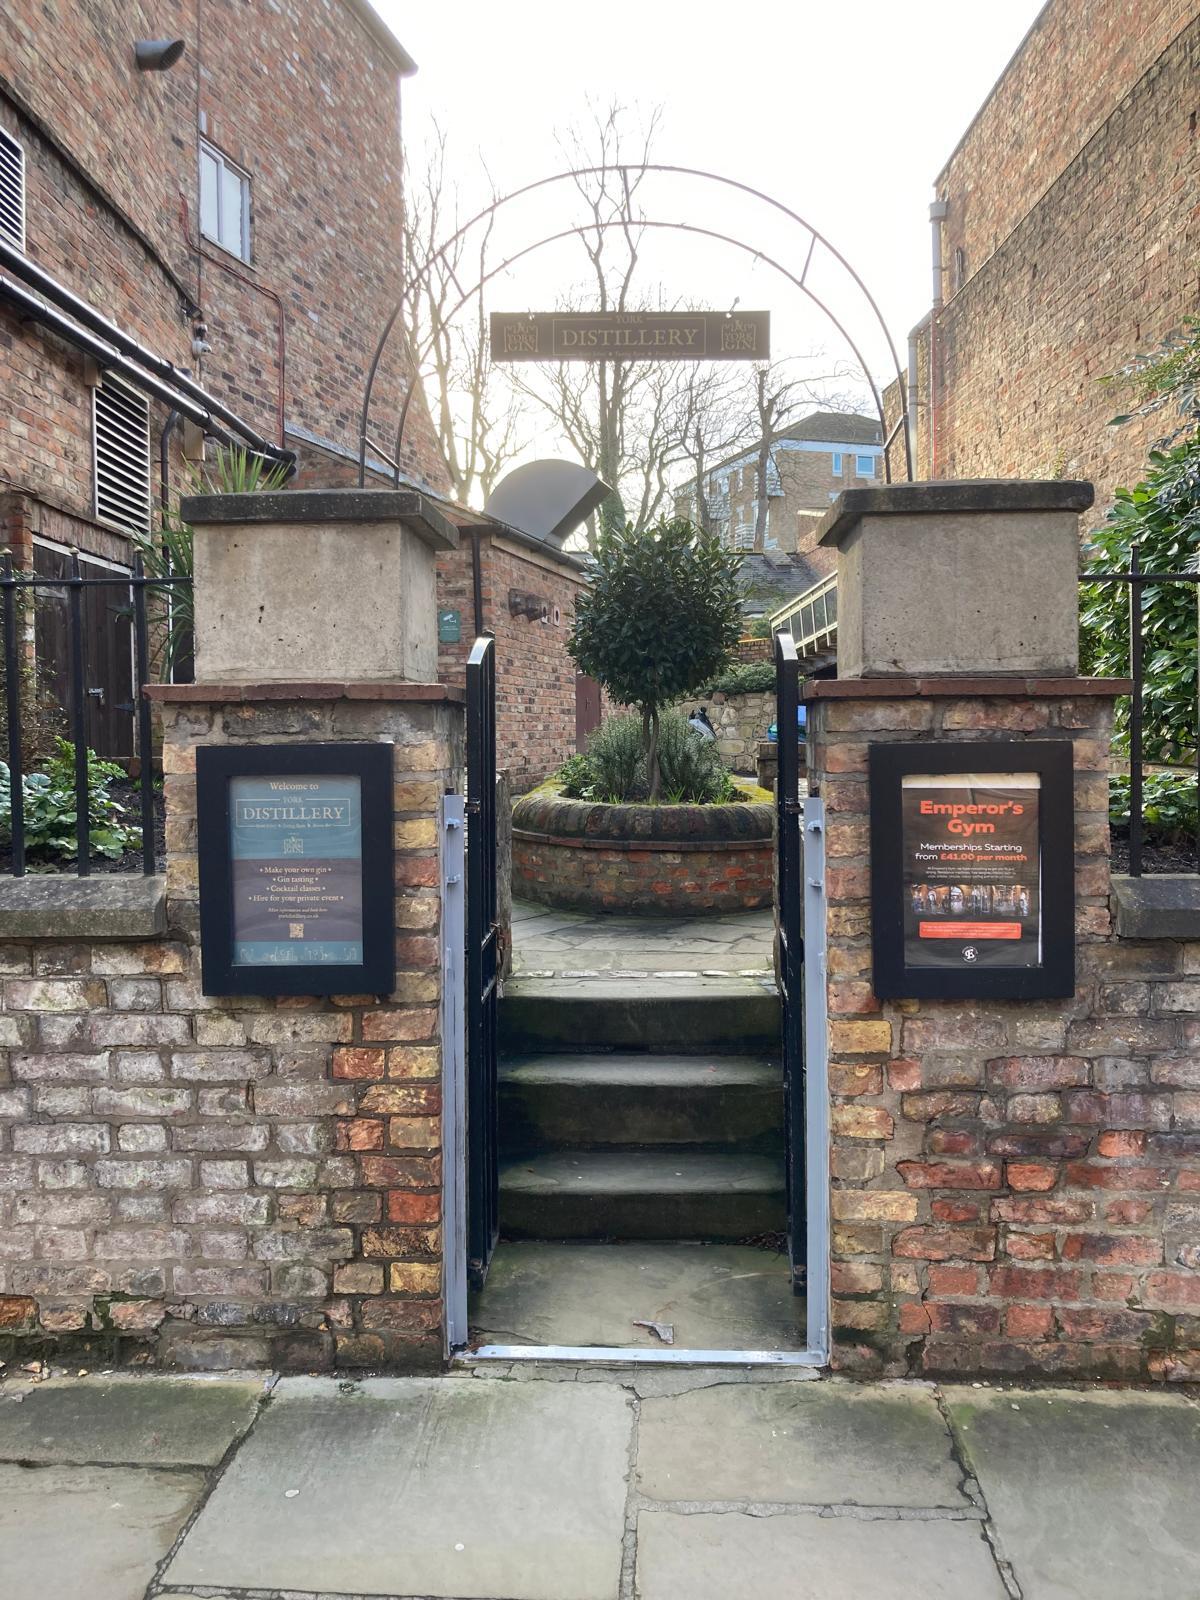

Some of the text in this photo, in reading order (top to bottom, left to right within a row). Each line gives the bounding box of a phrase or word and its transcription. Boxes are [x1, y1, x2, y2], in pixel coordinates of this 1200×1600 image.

[562, 329, 699, 346] DISTILLERY
[269, 782, 308, 790] Welcome
[243, 807, 345, 820] DISTILLERY
[920, 800, 1024, 818] Emperor's
[947, 818, 996, 837] Gym
[920, 843, 1022, 853] Memberships Starting
[915, 852, 938, 860] from
[940, 853, 975, 861] £41.00
[976, 854, 994, 862] per
[315, 867, 327, 875] gin
[291, 876, 314, 884] tasting
[297, 895, 320, 903] private
